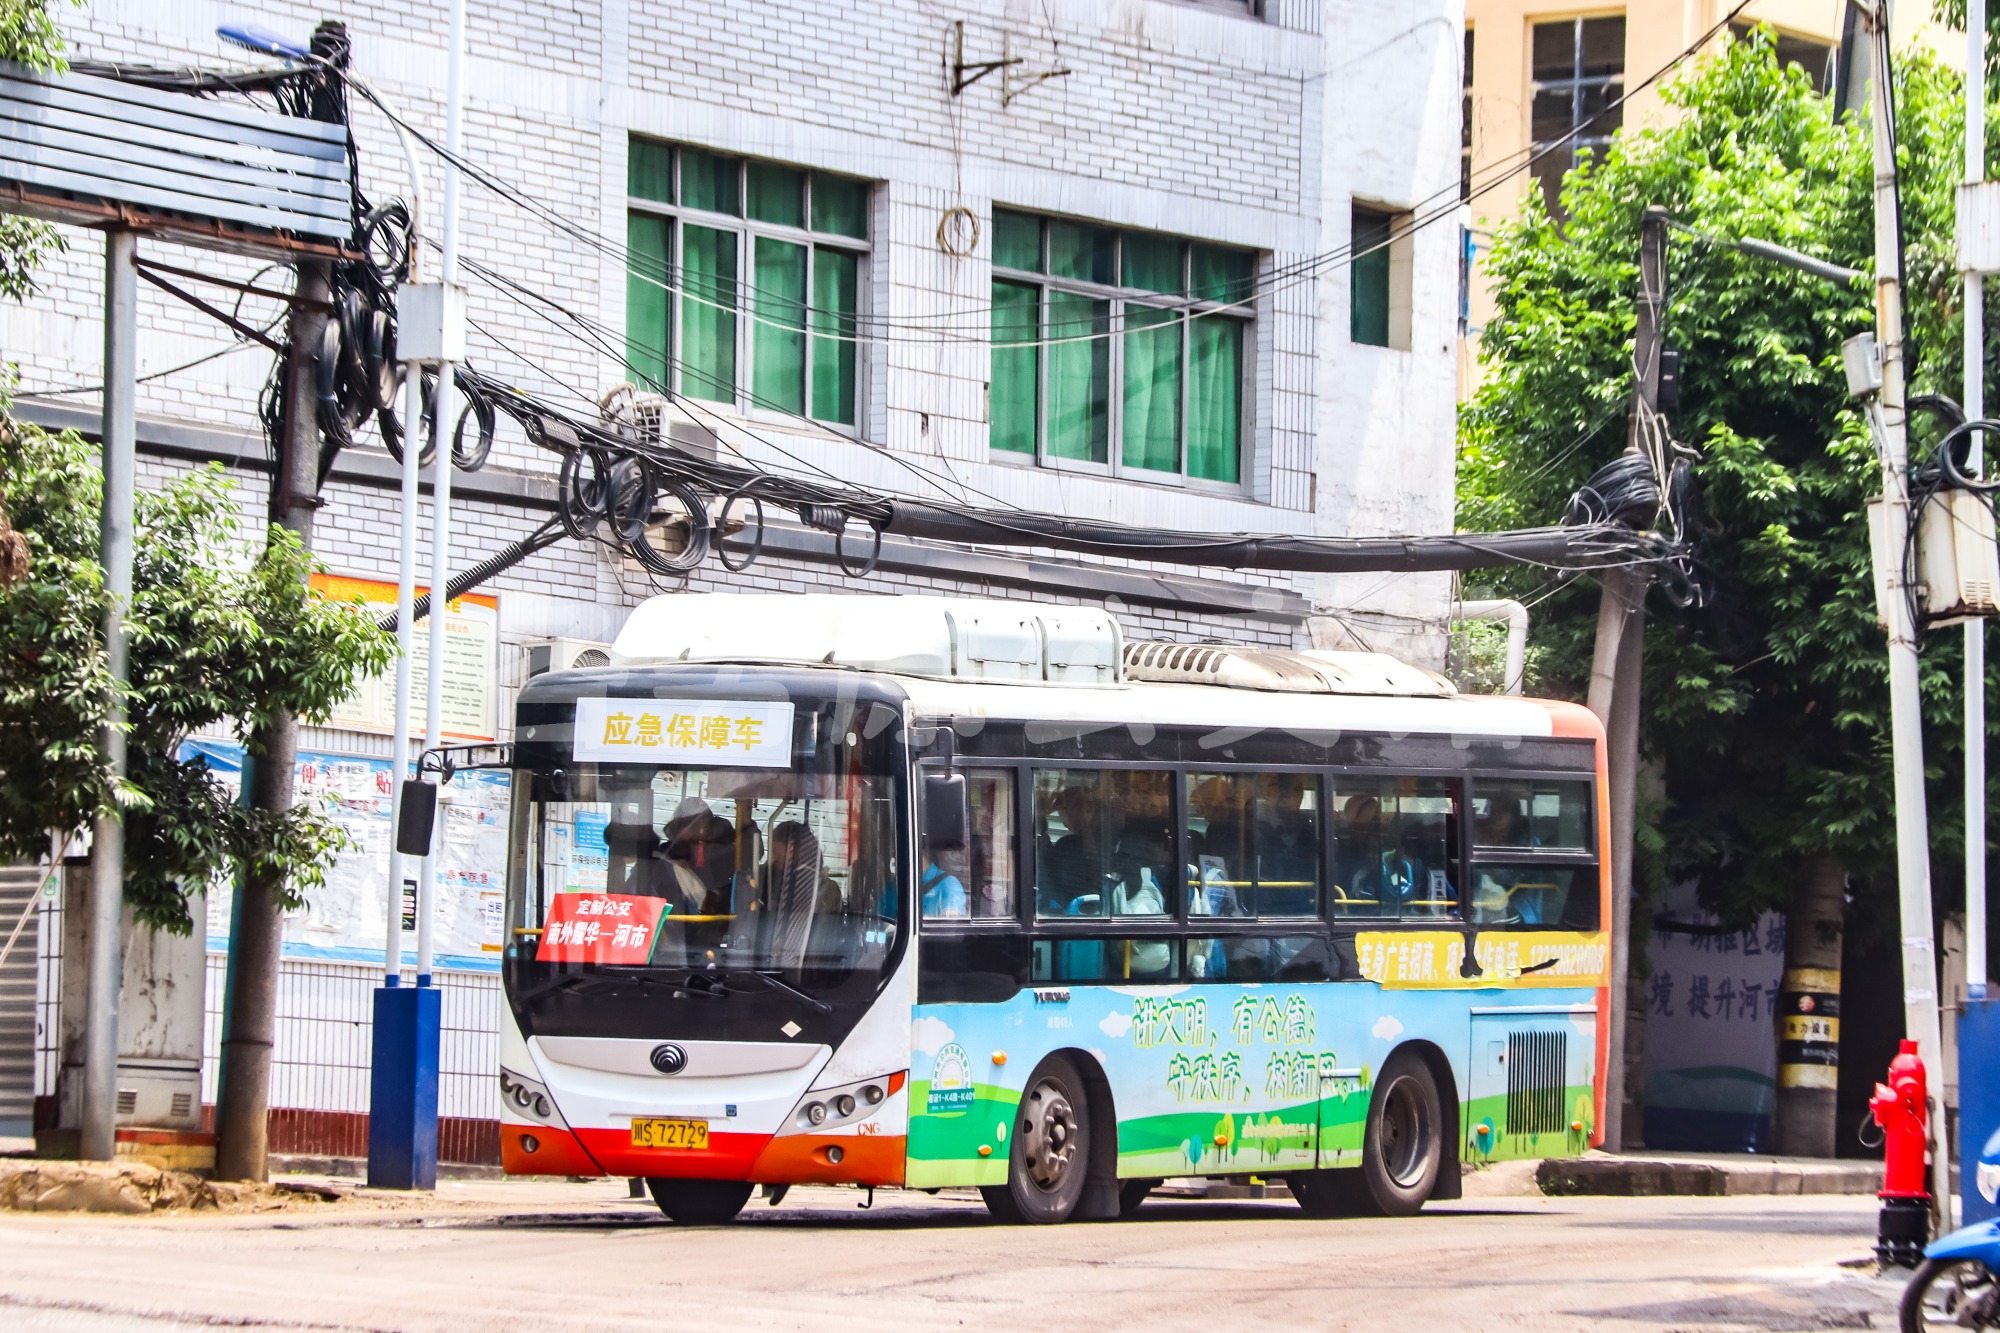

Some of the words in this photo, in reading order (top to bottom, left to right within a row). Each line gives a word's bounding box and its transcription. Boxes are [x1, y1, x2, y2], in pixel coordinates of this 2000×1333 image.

[602, 712, 764, 751] 应急保障车
[576, 899, 633, 917] 定制公交
[857, 1122, 880, 1136] CNG
